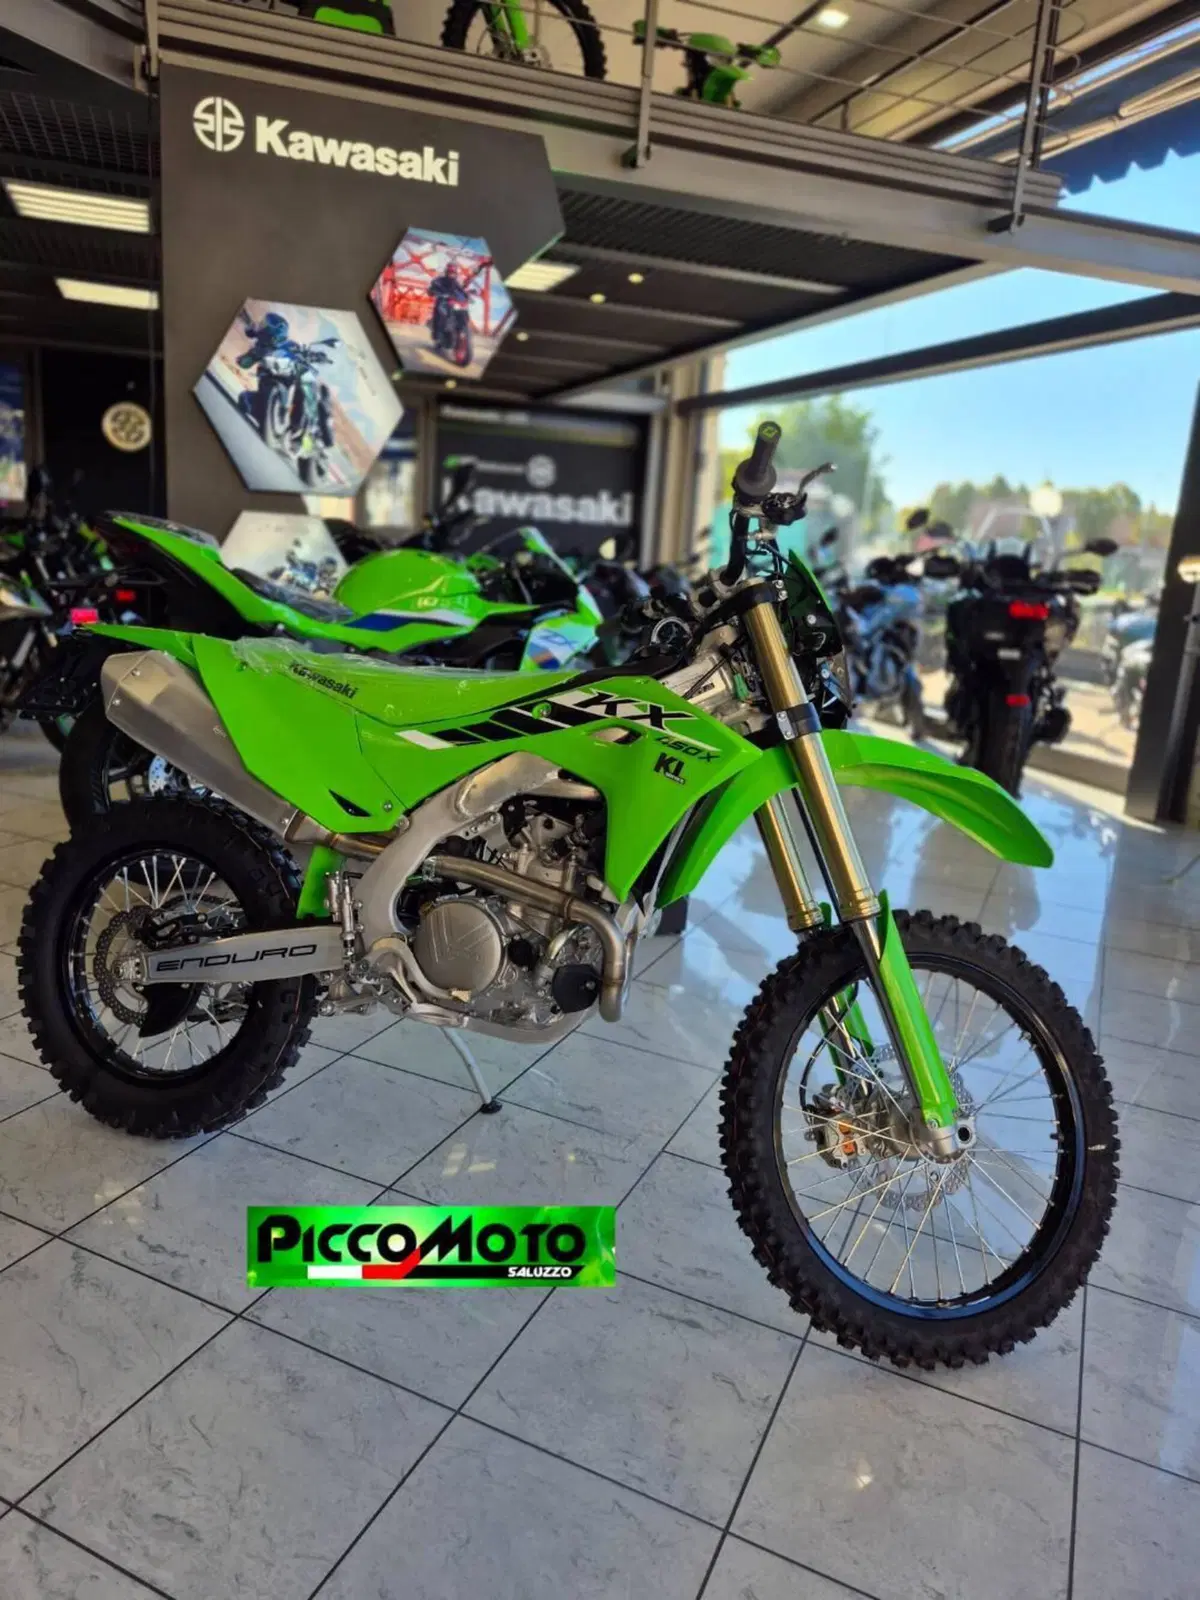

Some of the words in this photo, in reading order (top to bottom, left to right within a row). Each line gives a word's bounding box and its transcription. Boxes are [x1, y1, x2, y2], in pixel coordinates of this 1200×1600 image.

[256, 115, 459, 186] Kawasaki
[573, 688, 698, 732] KX
[156, 944, 317, 972] ENDURO
